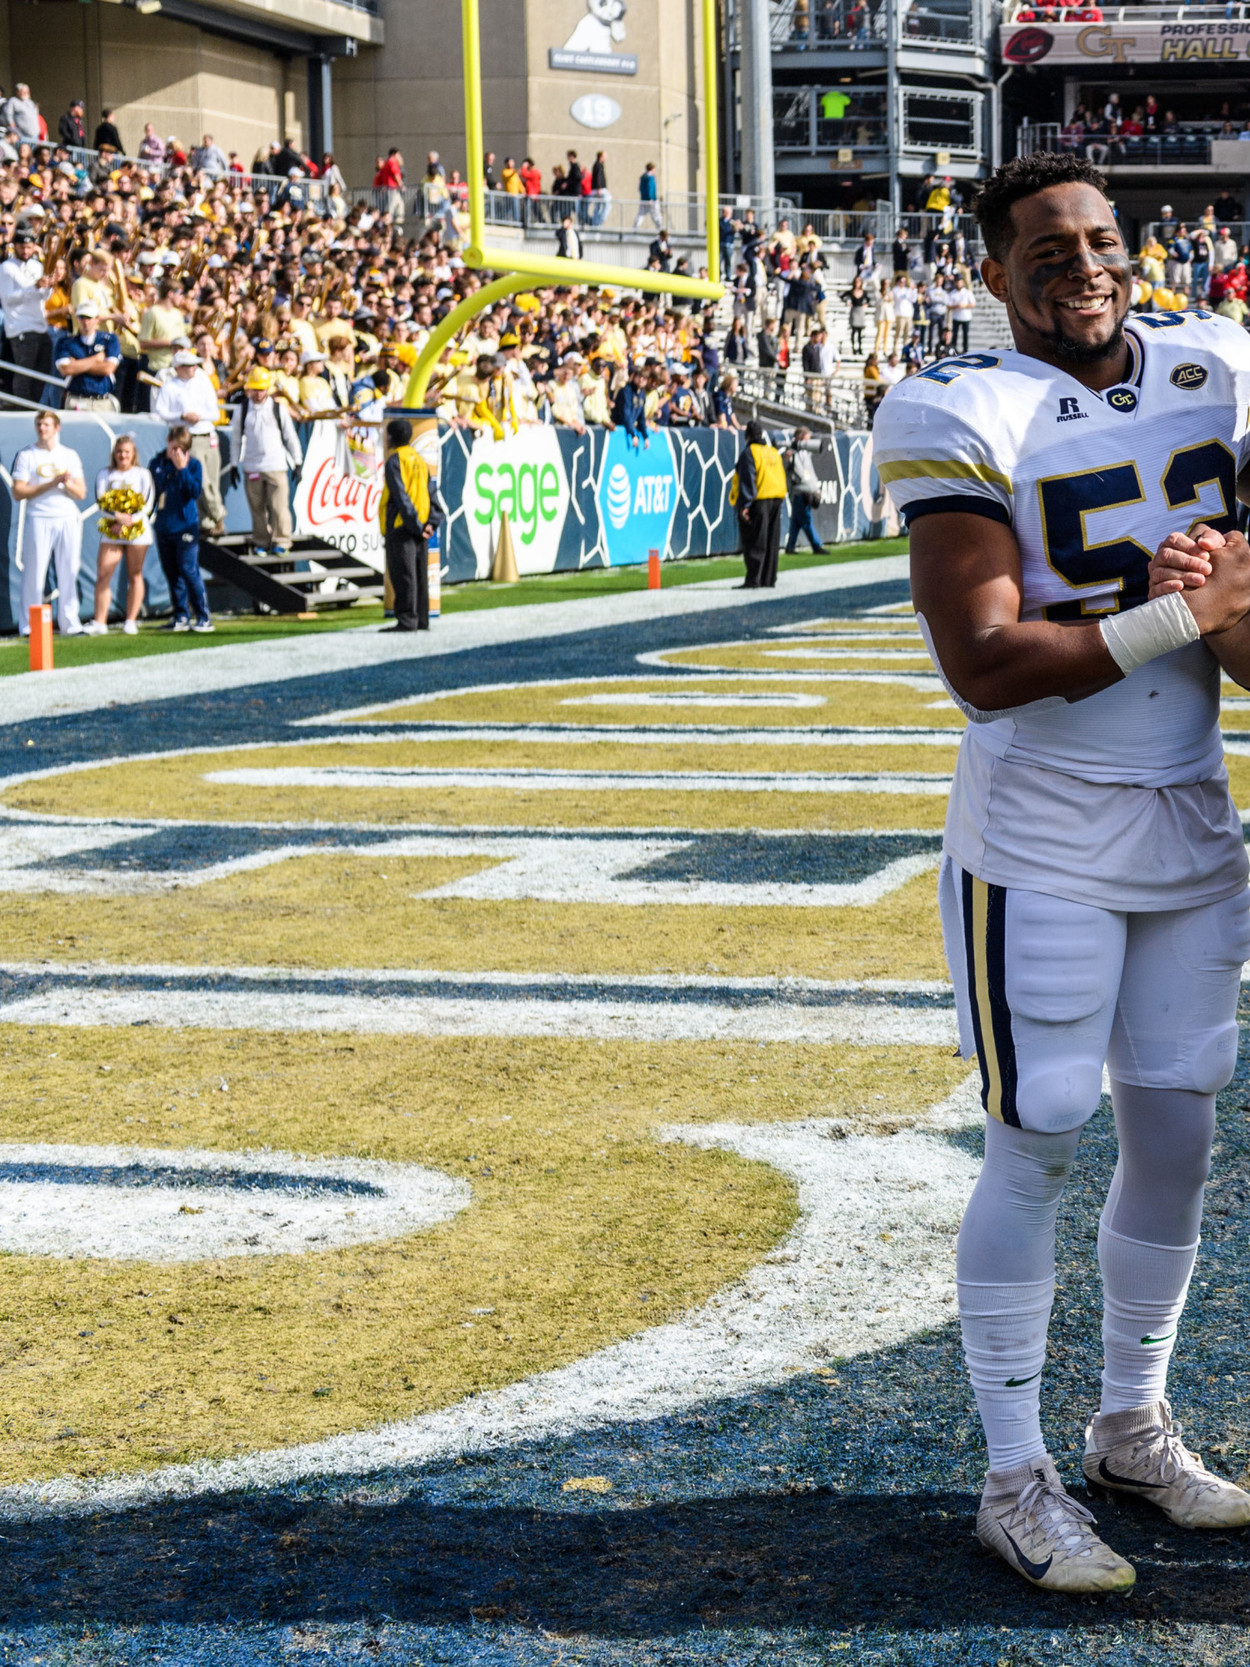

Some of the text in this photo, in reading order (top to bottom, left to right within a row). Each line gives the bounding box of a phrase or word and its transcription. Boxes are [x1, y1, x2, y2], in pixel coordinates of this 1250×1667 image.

[1160, 37, 1238, 62] HALL
[580, 98, 612, 122] 19
[1176, 366, 1204, 385] ACC
[1056, 412, 1090, 423] RUSSELL
[1059, 396, 1080, 415] R
[474, 462, 560, 546] sage
[633, 474, 674, 516] AT&T
[1037, 437, 1239, 600] 52
